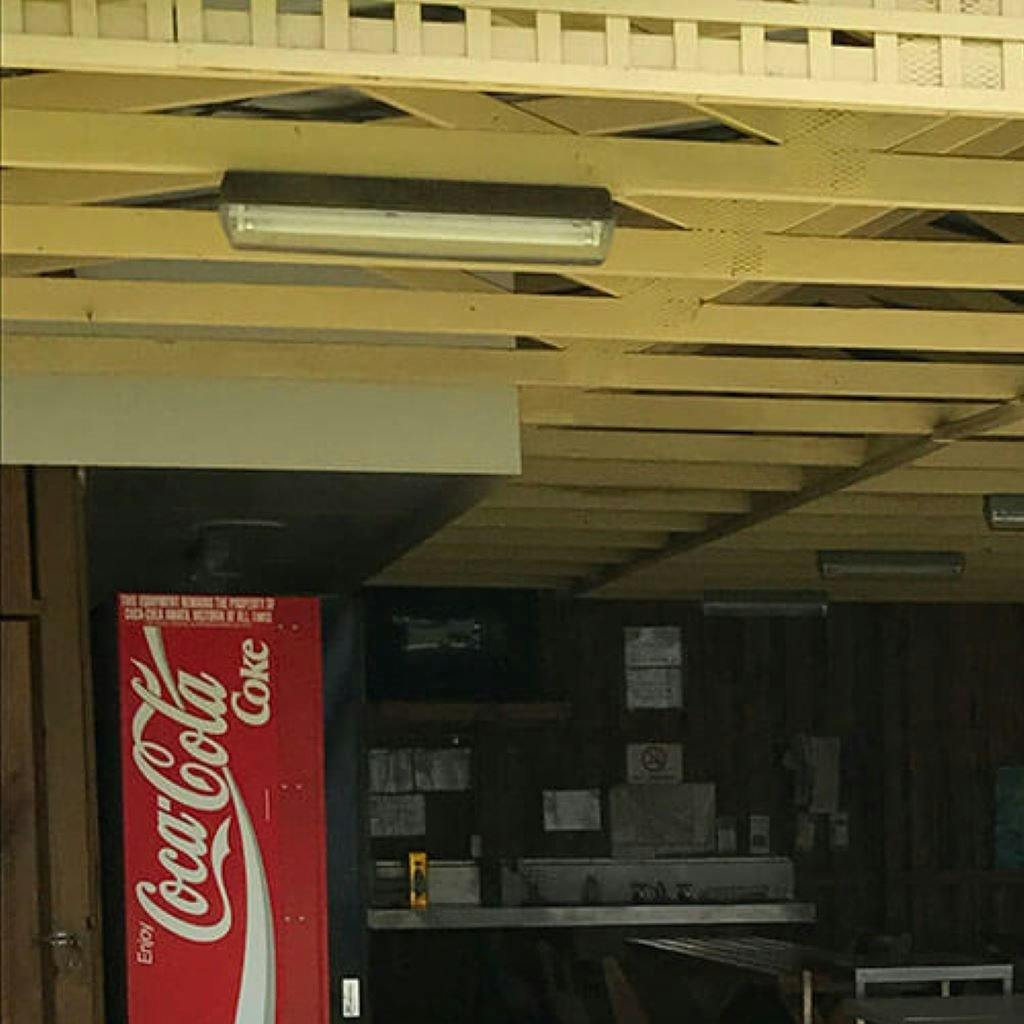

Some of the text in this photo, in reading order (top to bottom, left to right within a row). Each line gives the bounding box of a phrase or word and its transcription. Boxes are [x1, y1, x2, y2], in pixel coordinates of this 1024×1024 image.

[231, 638, 271, 725] Coke
[131, 652, 232, 942] Coca-Cola
[136, 921, 155, 964] Enjoy
